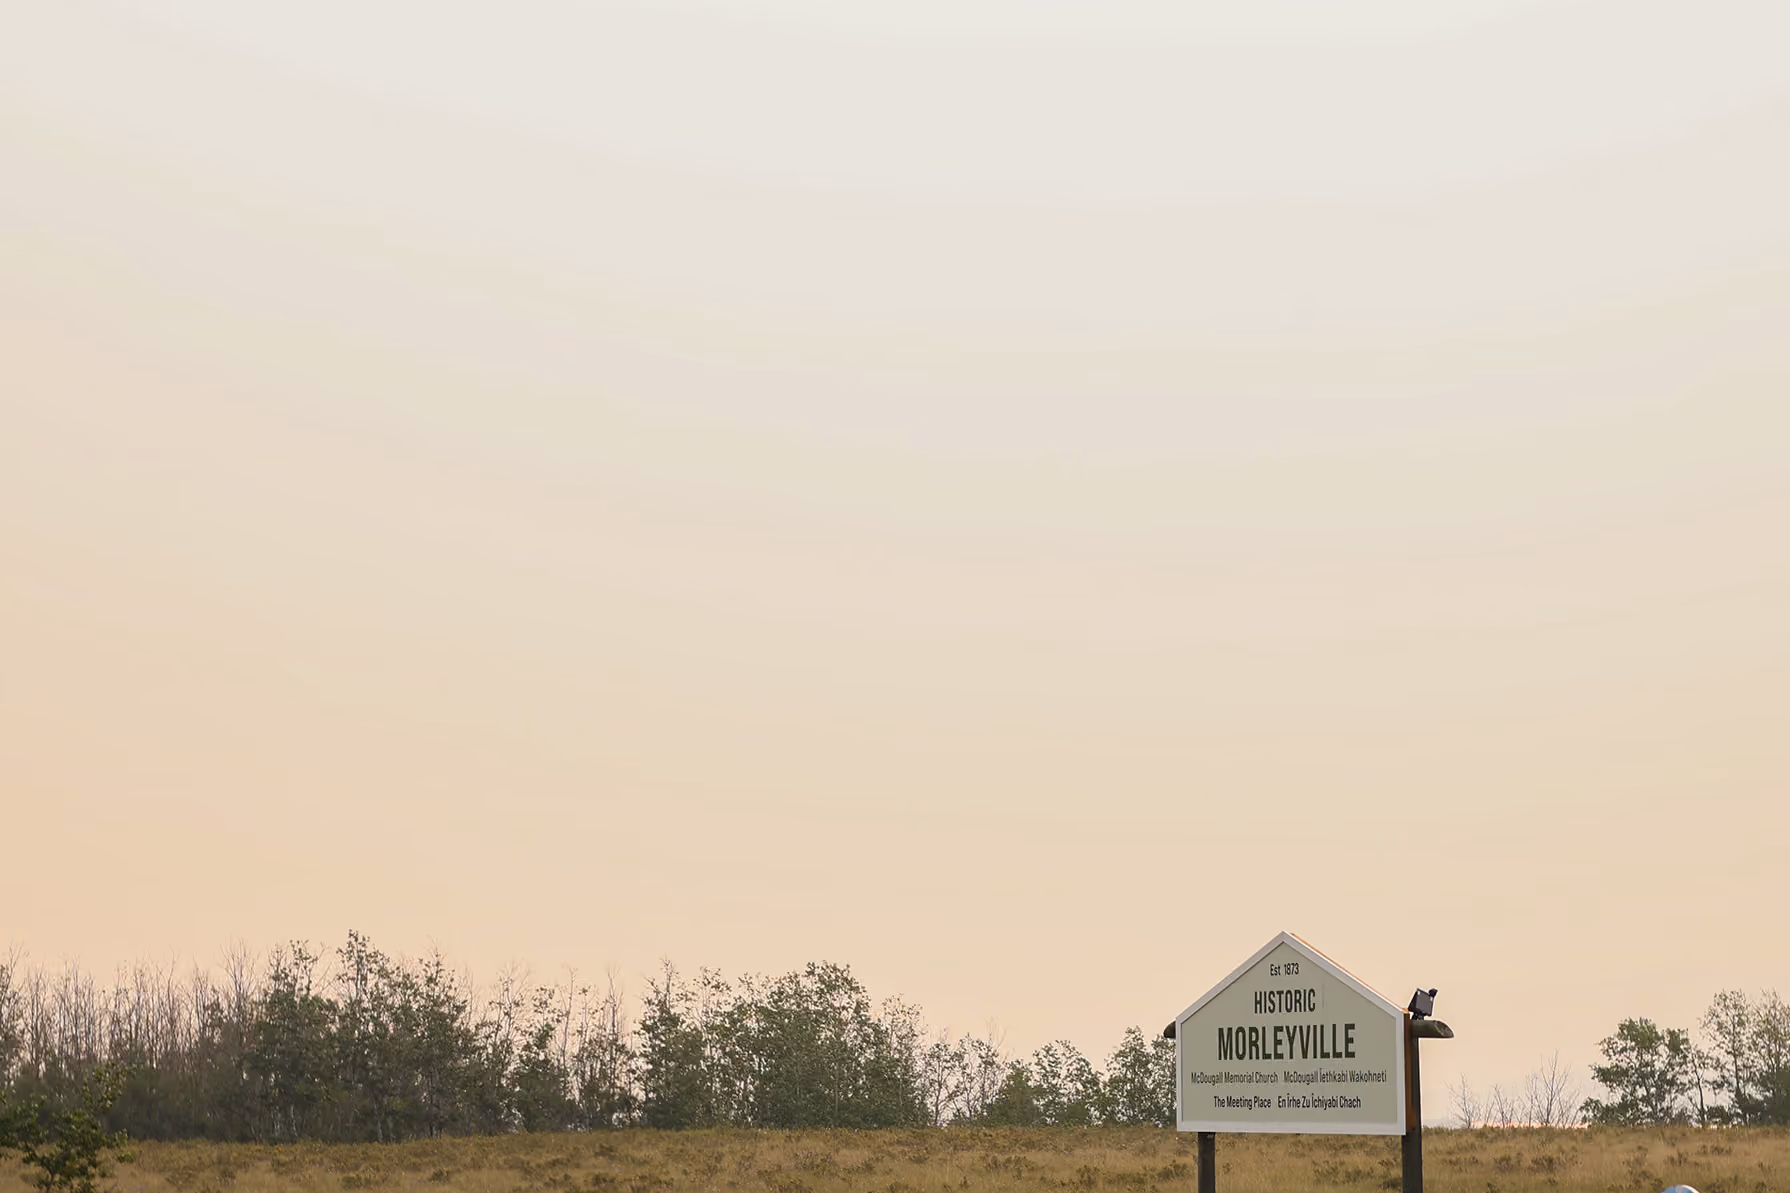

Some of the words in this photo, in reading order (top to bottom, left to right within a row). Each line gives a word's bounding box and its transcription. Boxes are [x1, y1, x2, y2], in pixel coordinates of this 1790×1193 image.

[1270, 964, 1281, 976] Est
[1284, 963, 1299, 976] 1873
[1254, 988, 1316, 1014] HISTORIC
[1218, 1023, 1356, 1061] MORLEYVILLE
[1191, 1071, 1223, 1086] McDougall
[1224, 1071, 1254, 1083] Memorial
[1254, 1071, 1278, 1083] Church
[1283, 1070, 1318, 1085] McDougall
[1213, 1095, 1225, 1108] The
[1226, 1095, 1253, 1110] Meeting
[1253, 1095, 1271, 1108] Place
[1301, 1095, 1311, 1108] Zu
